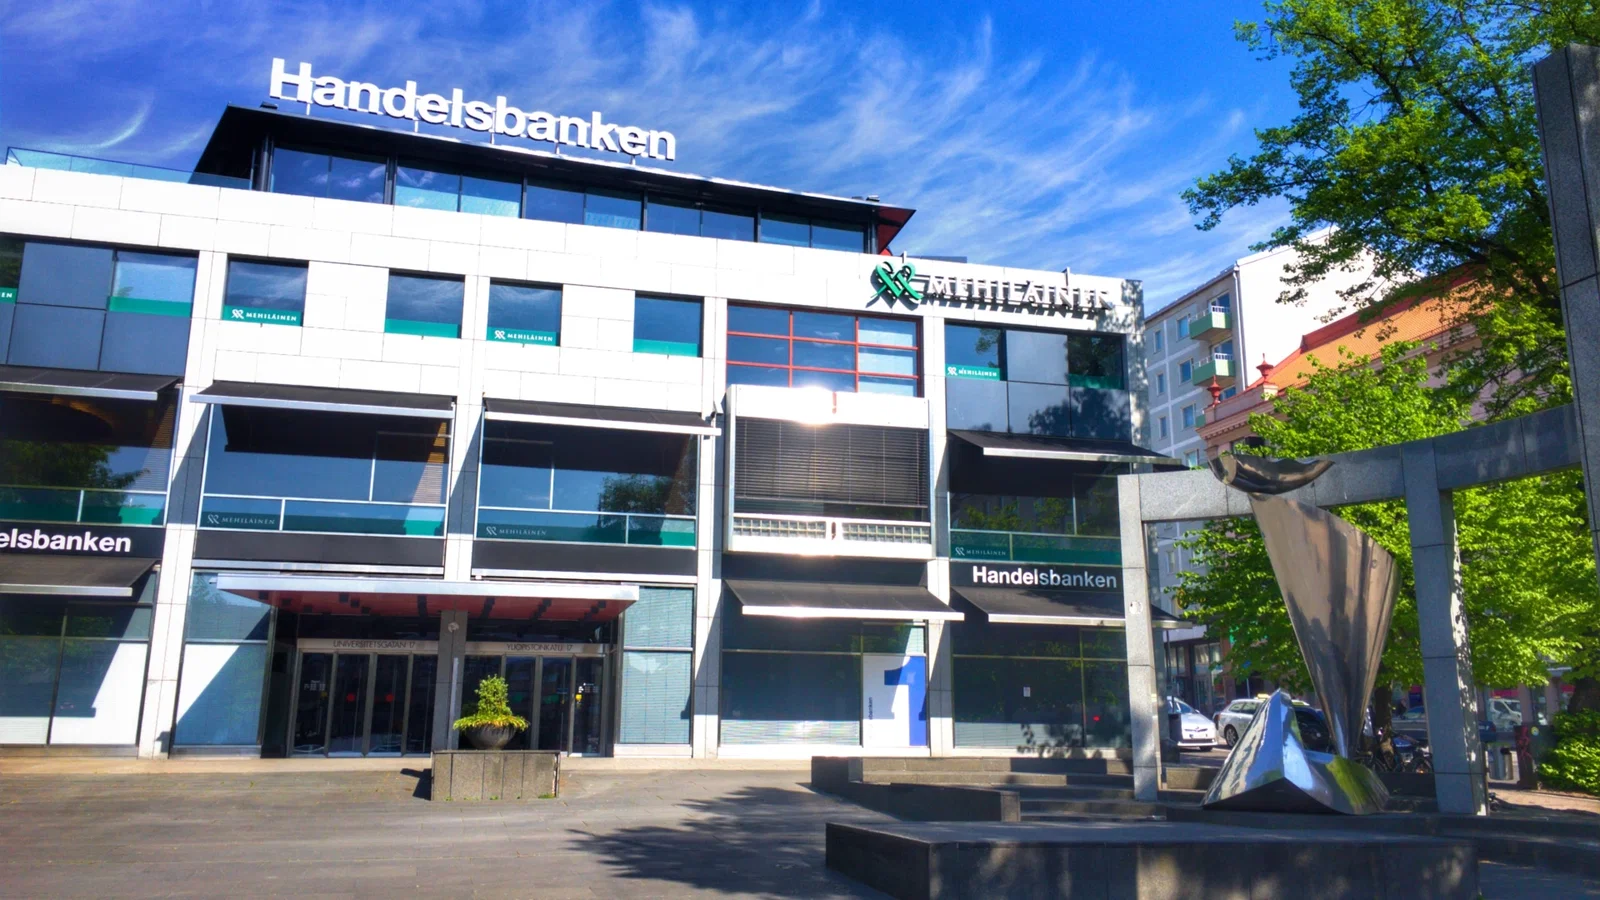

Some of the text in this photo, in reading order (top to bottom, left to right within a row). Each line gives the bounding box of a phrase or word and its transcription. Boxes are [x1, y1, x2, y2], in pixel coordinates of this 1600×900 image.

[269, 58, 676, 161] Handelsbanken
[245, 311, 297, 322] MEHILÄINEN
[507, 333, 553, 342] MEHILÄINEN
[0, 528, 131, 553] elsbanken
[972, 565, 1117, 588] Handelsbanken
